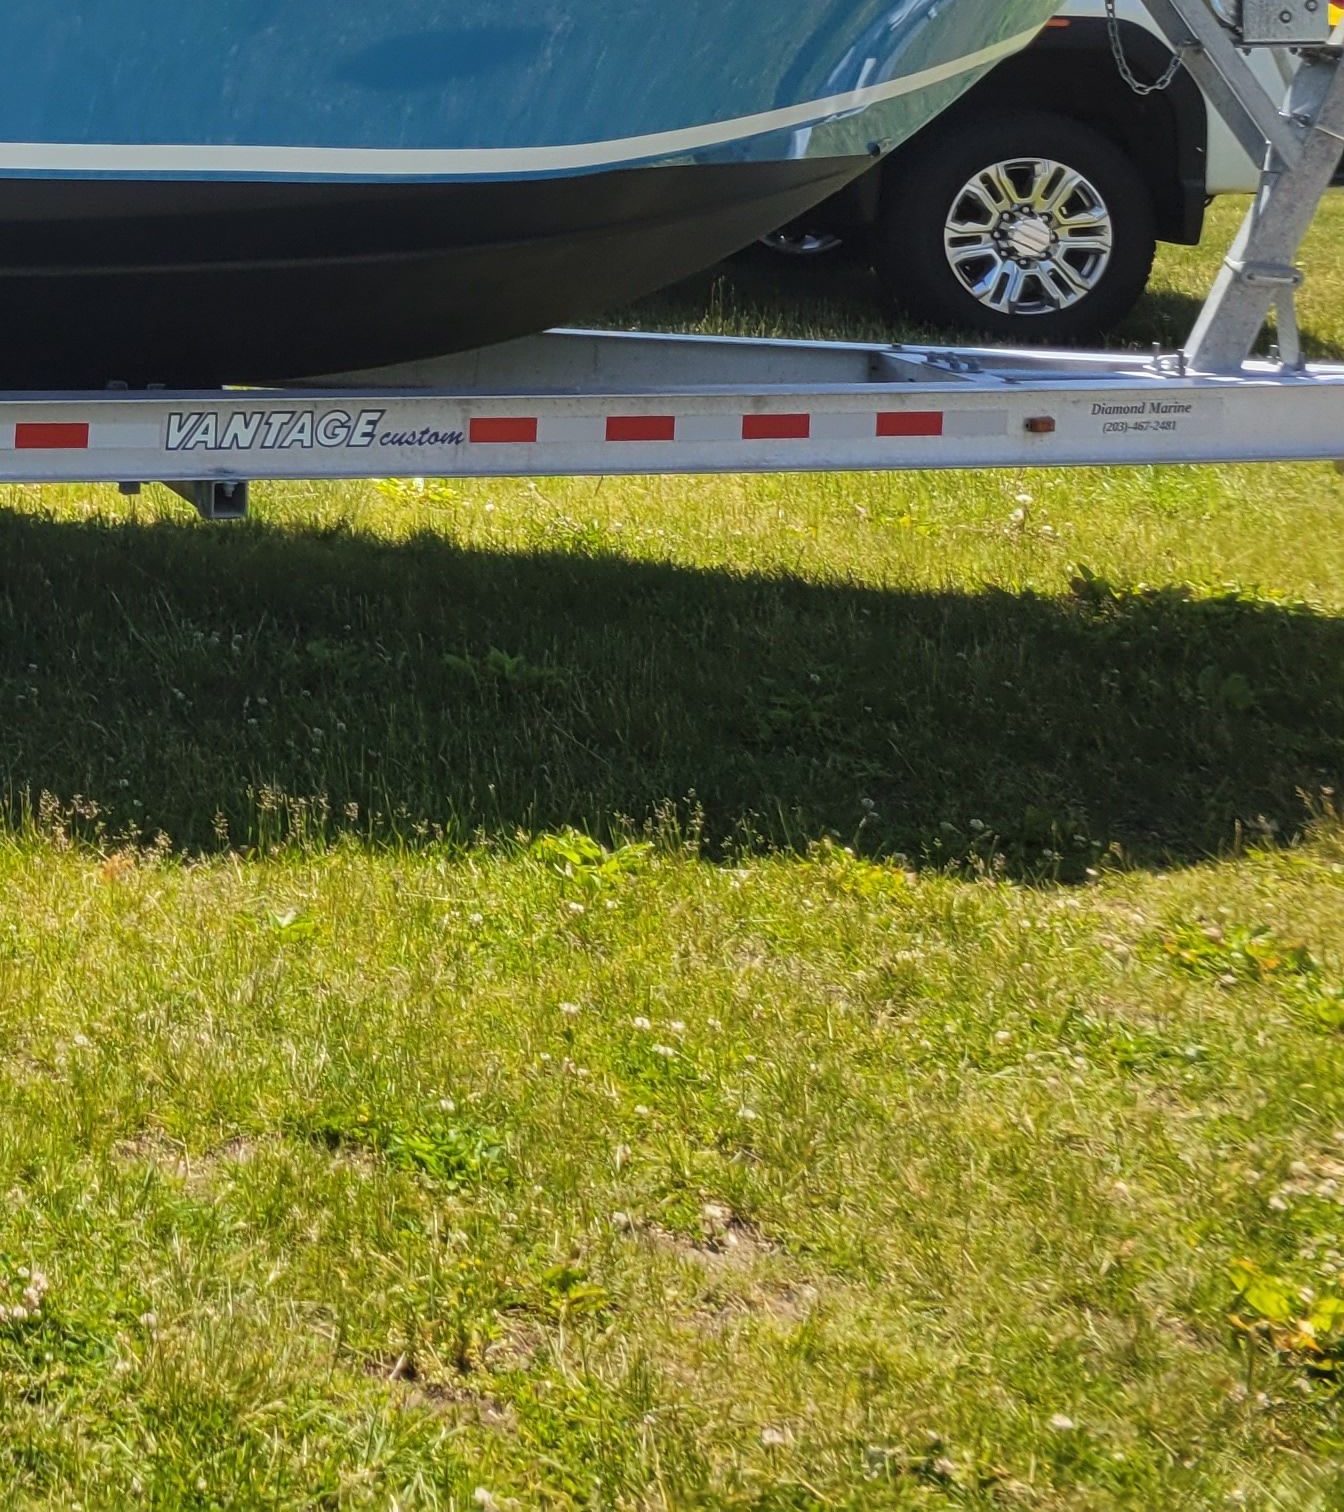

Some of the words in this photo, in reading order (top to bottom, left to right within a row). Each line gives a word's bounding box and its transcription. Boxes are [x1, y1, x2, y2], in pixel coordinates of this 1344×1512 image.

[1091, 402, 1146, 415] Diamond
[1148, 402, 1192, 414] Marine
[165, 409, 386, 450] VANTAGE
[379, 427, 463, 447] custom
